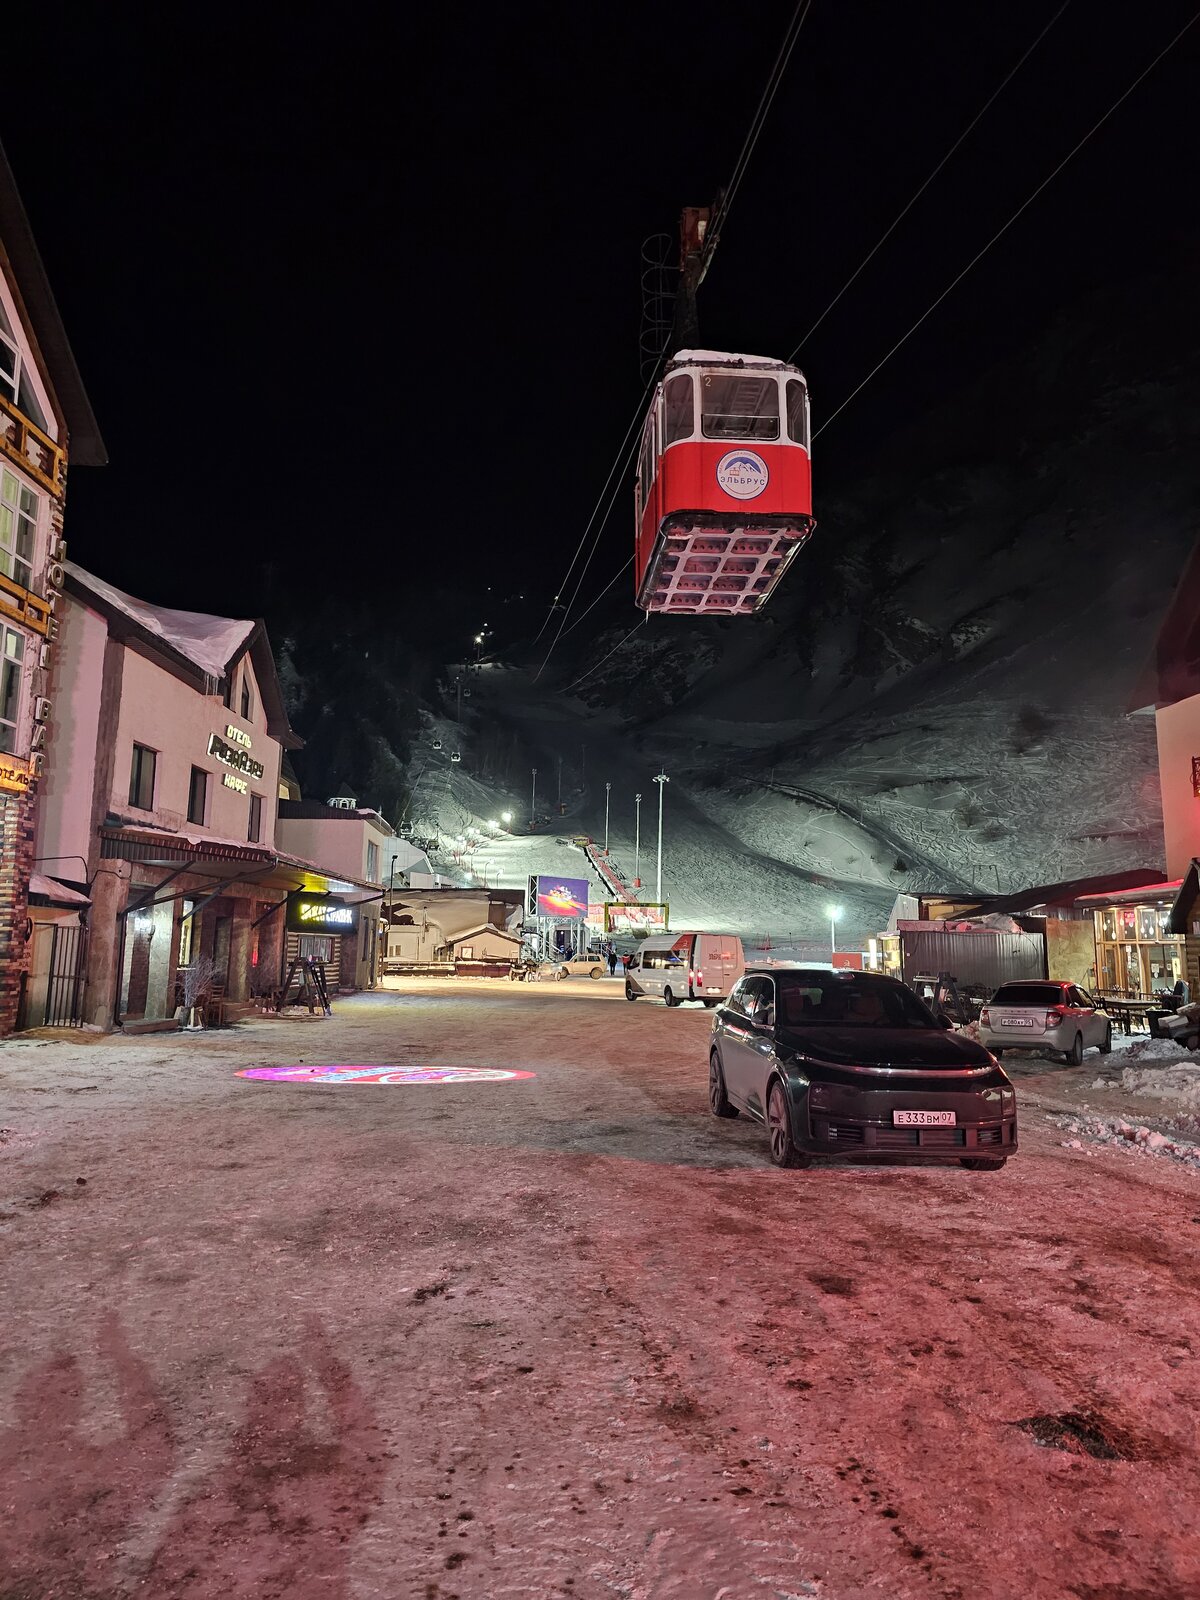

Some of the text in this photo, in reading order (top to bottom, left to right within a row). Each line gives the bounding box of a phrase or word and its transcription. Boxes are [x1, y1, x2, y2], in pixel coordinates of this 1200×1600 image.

[705, 377, 712, 387] 2
[720, 476, 765, 486] ЭЛЬБРУС
[226, 724, 252, 748] ОТЕЛЬ
[223, 773, 248, 795] КАФЕ
